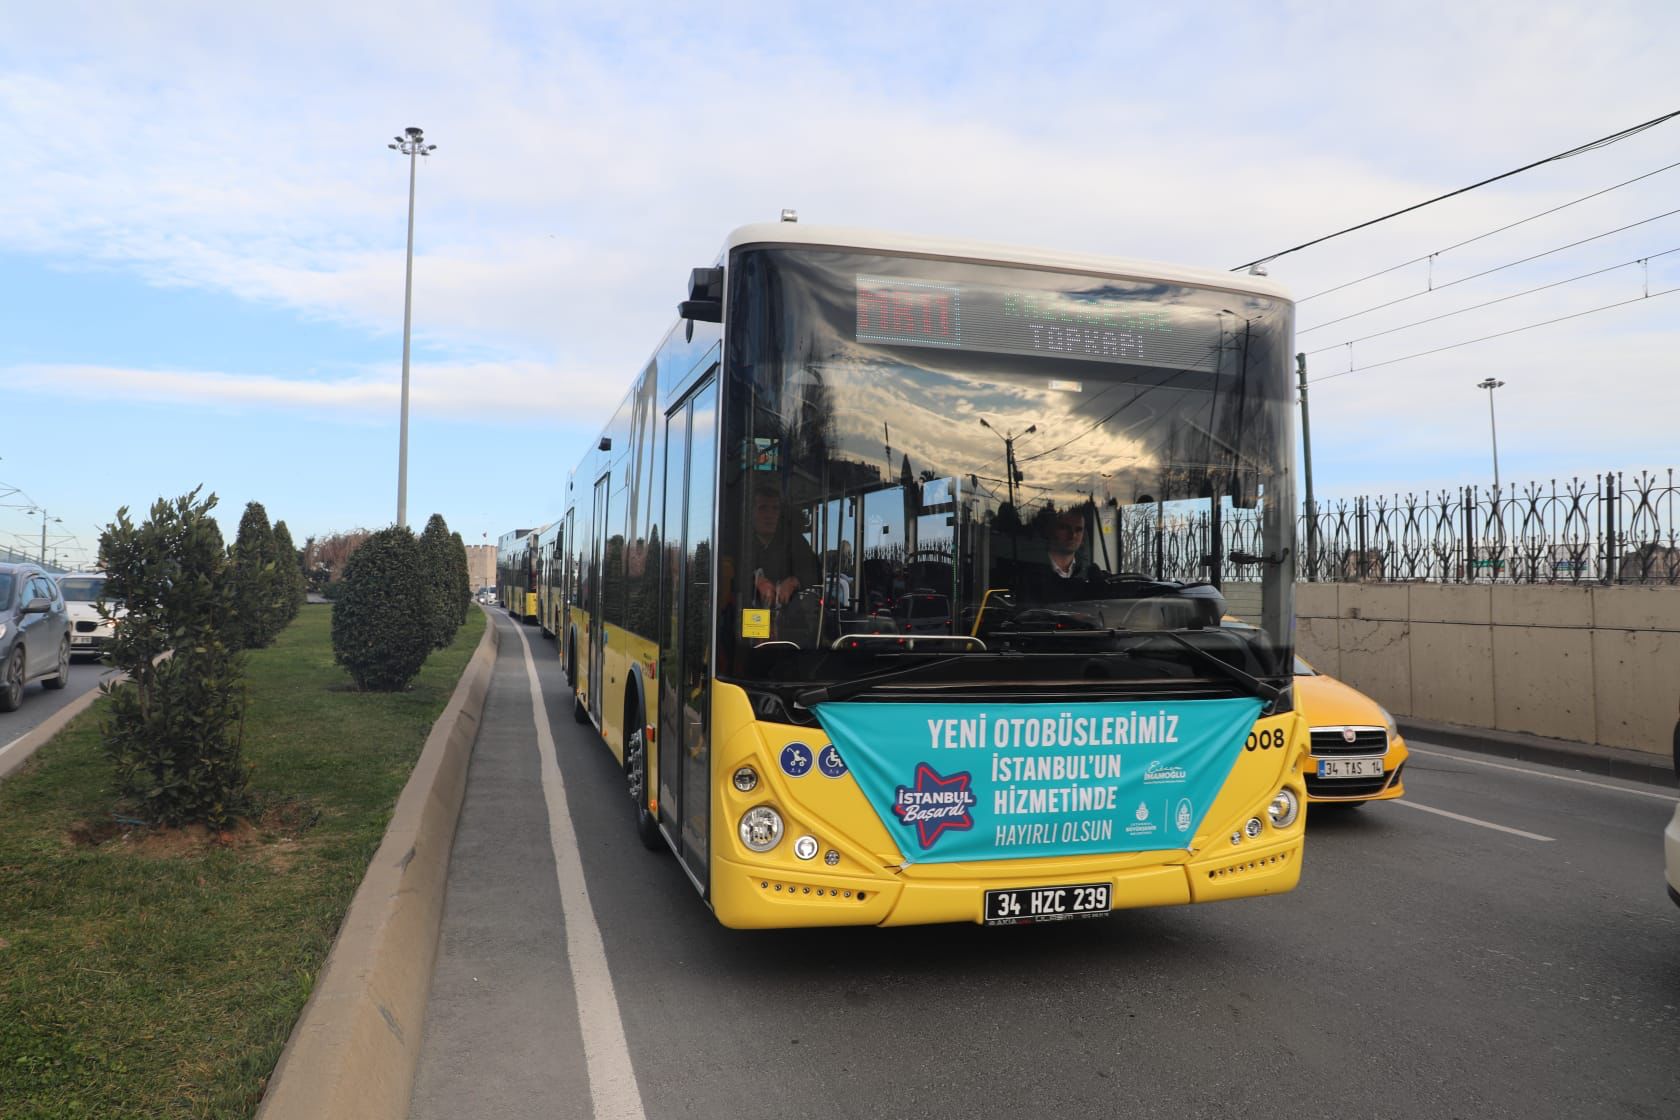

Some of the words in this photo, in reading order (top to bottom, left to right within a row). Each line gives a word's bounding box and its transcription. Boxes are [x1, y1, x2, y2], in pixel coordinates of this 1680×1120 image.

[1029, 323, 1144, 358] TOPKAPI
[927, 713, 988, 749] YENİ
[993, 710, 1180, 748] OTOBÜSLERİMİZ
[1326, 761, 1338, 775] 34
[1344, 761, 1362, 775] TAS
[1371, 760, 1381, 774] 14
[898, 789, 973, 805] İSTANBUL
[903, 800, 966, 822] Başardı
[994, 783, 1118, 815] HİZMETİNDE
[995, 822, 1058, 847] HAYIRLI
[1061, 819, 1113, 843] OLSUN
[997, 893, 1021, 916] 34
[1031, 889, 1066, 914] HZC
[1073, 887, 1107, 911] 239
